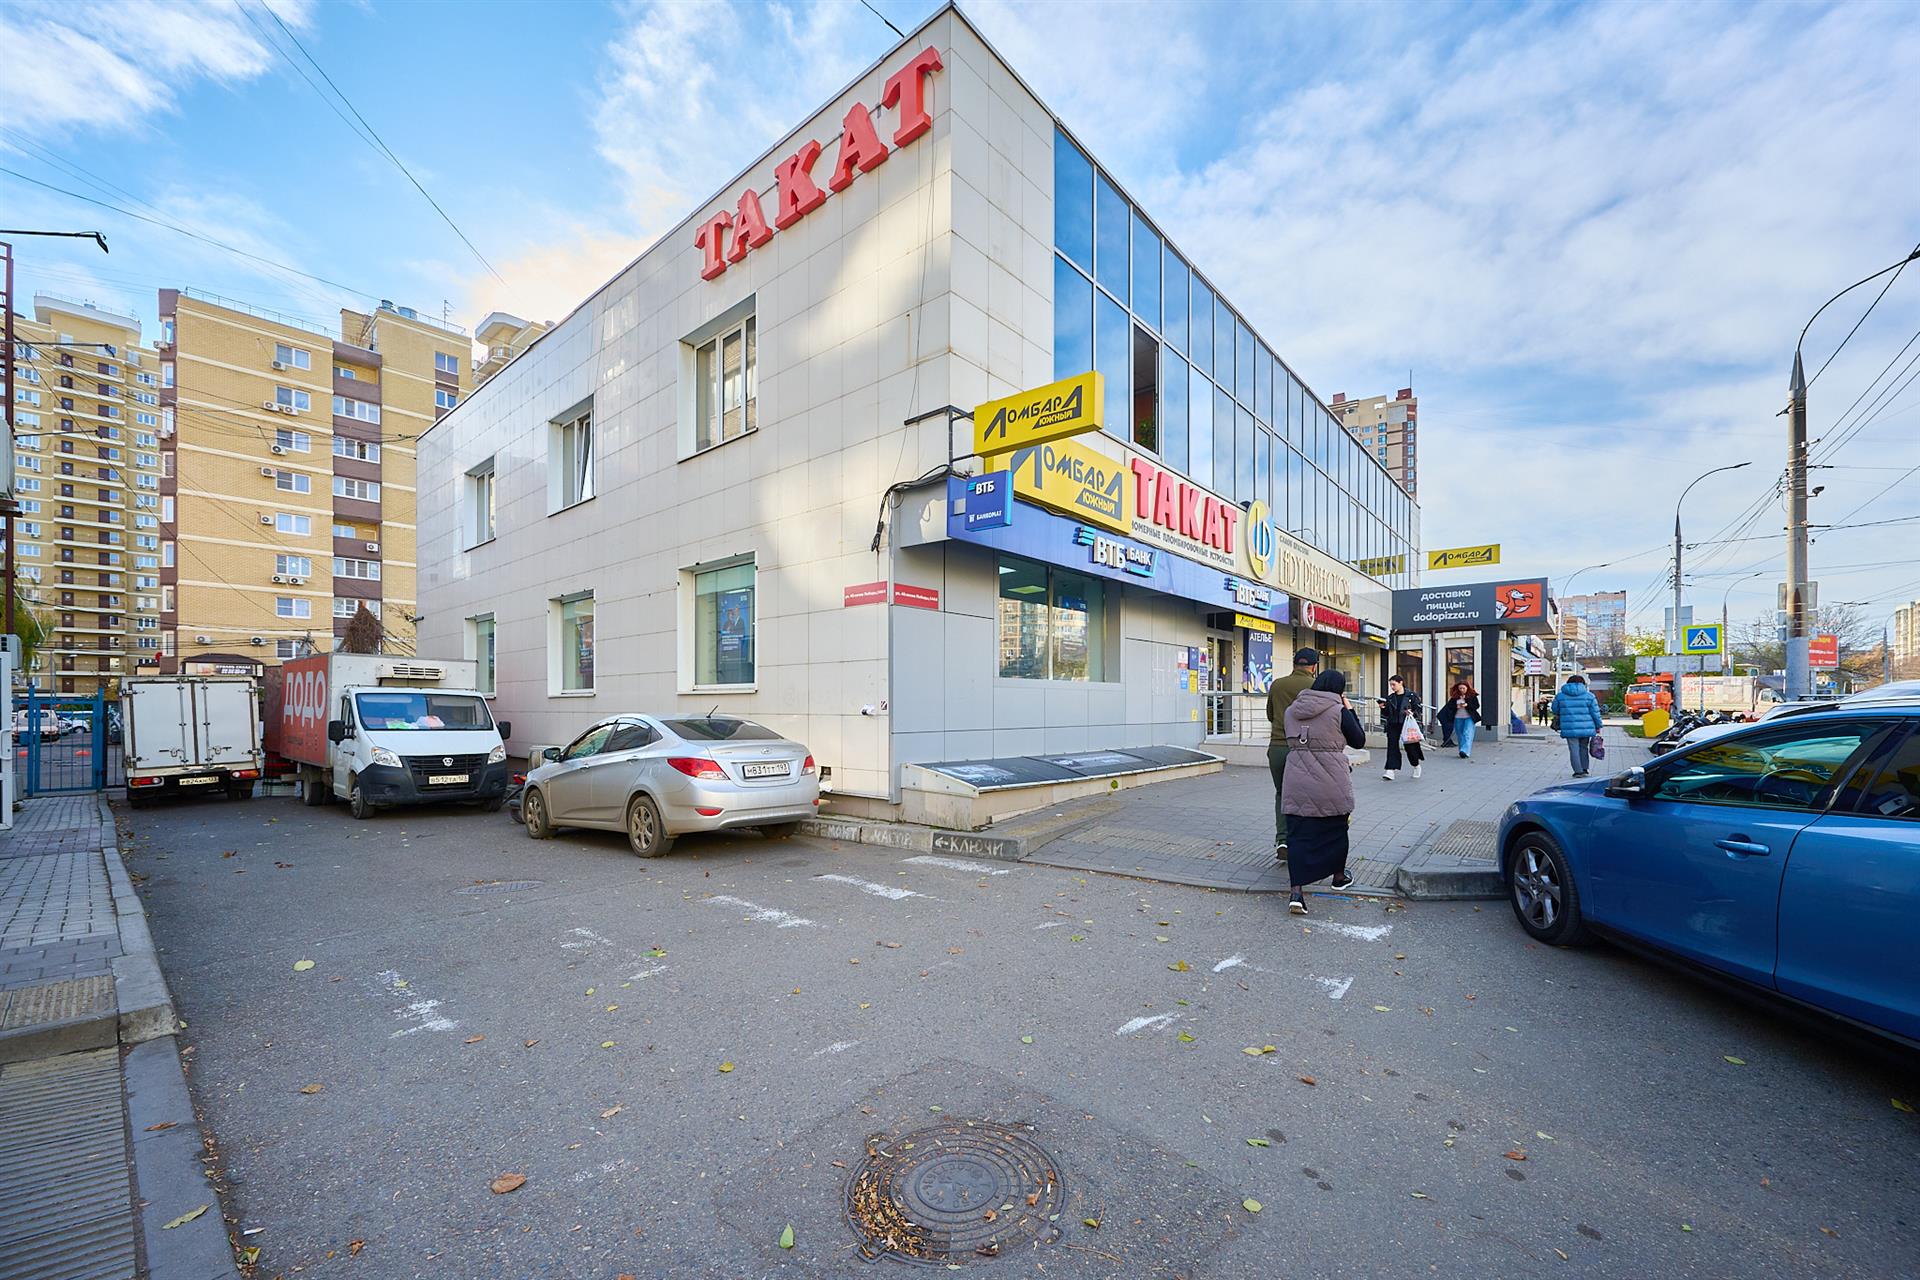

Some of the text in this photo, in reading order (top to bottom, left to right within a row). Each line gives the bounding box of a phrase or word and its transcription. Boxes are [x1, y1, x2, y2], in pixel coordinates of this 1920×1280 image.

[694, 45, 944, 281] ТАКАТ
[984, 385, 1083, 442] ЛОМБАРД
[976, 481, 995, 495] ВТБ
[1011, 444, 1123, 522] ЛОМБАРД
[1131, 458, 1237, 553] ТАКАТ
[1093, 536, 1152, 568] ВТБ БАНК
[1433, 548, 1492, 566] ЛОМБАРД
[1279, 547, 1302, 590] LADY
[1236, 583, 1255, 606] ВТБ
[1421, 589, 1472, 602] доставка
[1426, 602, 1465, 610] пиццы:
[1413, 611, 1479, 623] dodopizza.ru
[1249, 632, 1272, 643] АТЕЛЬЕ
[284, 670, 326, 729] ДОДО
[950, 836, 1004, 857] КЛЮЧИ
